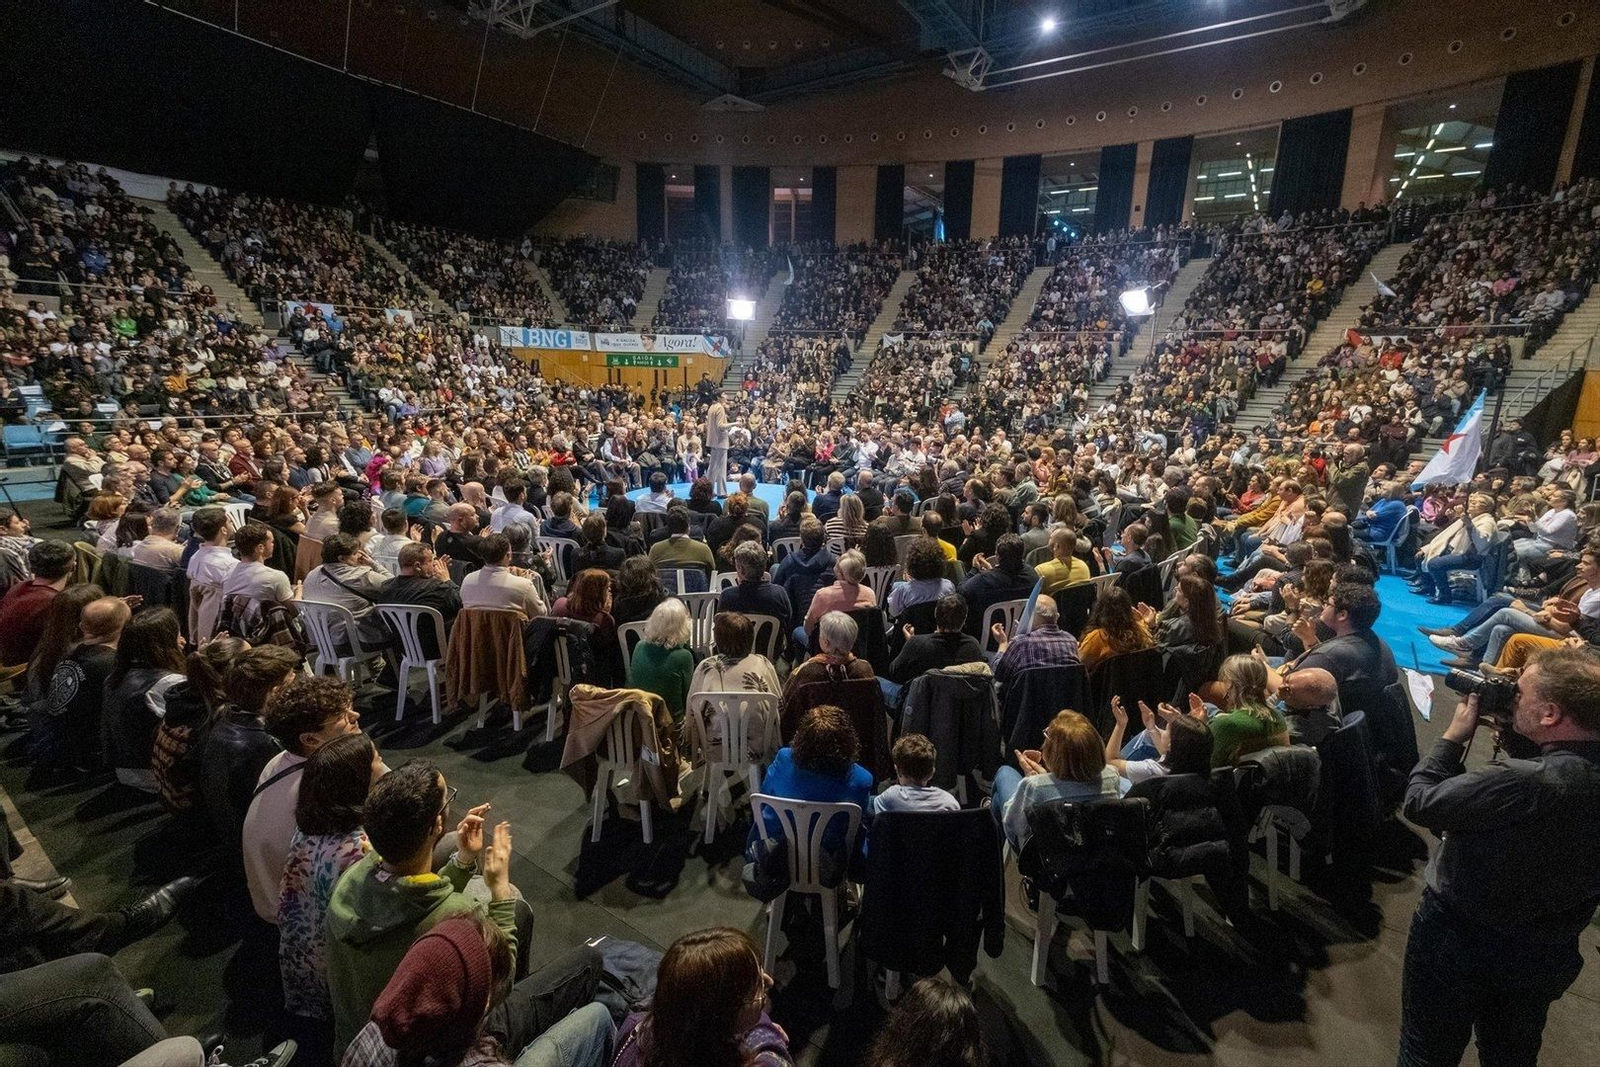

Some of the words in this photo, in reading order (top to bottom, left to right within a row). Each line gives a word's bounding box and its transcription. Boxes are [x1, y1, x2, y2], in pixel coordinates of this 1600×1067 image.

[528, 329, 567, 347] BNG
[575, 337, 588, 346] bng
[659, 336, 697, 350] Agora!
